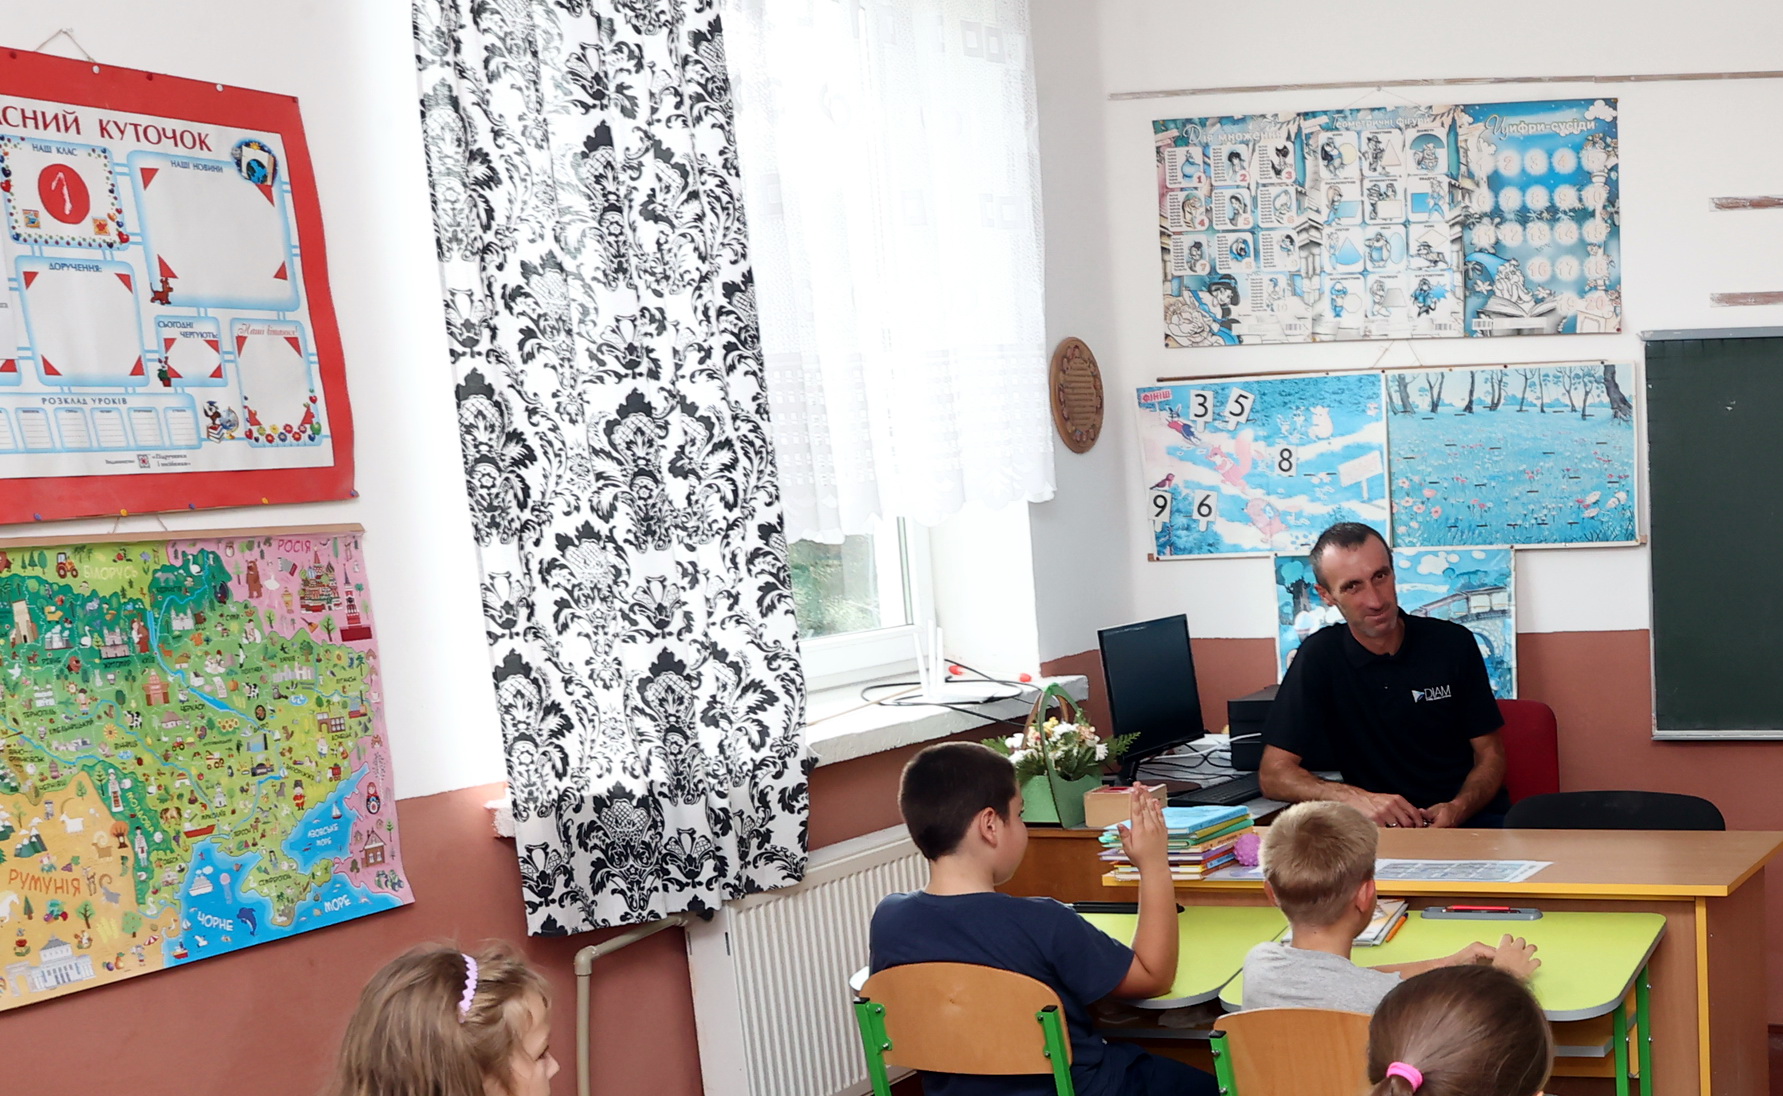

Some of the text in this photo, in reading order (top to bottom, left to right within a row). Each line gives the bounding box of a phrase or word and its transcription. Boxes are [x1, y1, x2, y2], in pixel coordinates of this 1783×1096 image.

[0, 105, 212, 152] СНИЙ КУТОЧОК
[1485, 114, 1596, 140] Цифри-сусіди
[32, 143, 77, 157] НАШ КЛАС
[42, 397, 127, 406] РОЗКЛАД УРОКІВ
[1142, 390, 1171, 401] ФІНІШ
[1193, 393, 1208, 418] 3
[1229, 393, 1249, 417] 5
[1278, 448, 1293, 472] 8
[1153, 494, 1168, 517] 9
[1197, 494, 1213, 517] 6
[278, 539, 311, 553] РОСІЯ
[83, 565, 138, 580] БІЛОРУСЬ
[1424, 685, 1451, 699] DIAM
[9, 869, 81, 897] РУМУНІЯ
[323, 894, 352, 913] МОРЕ
[197, 911, 234, 932] ЧОРНЕ
